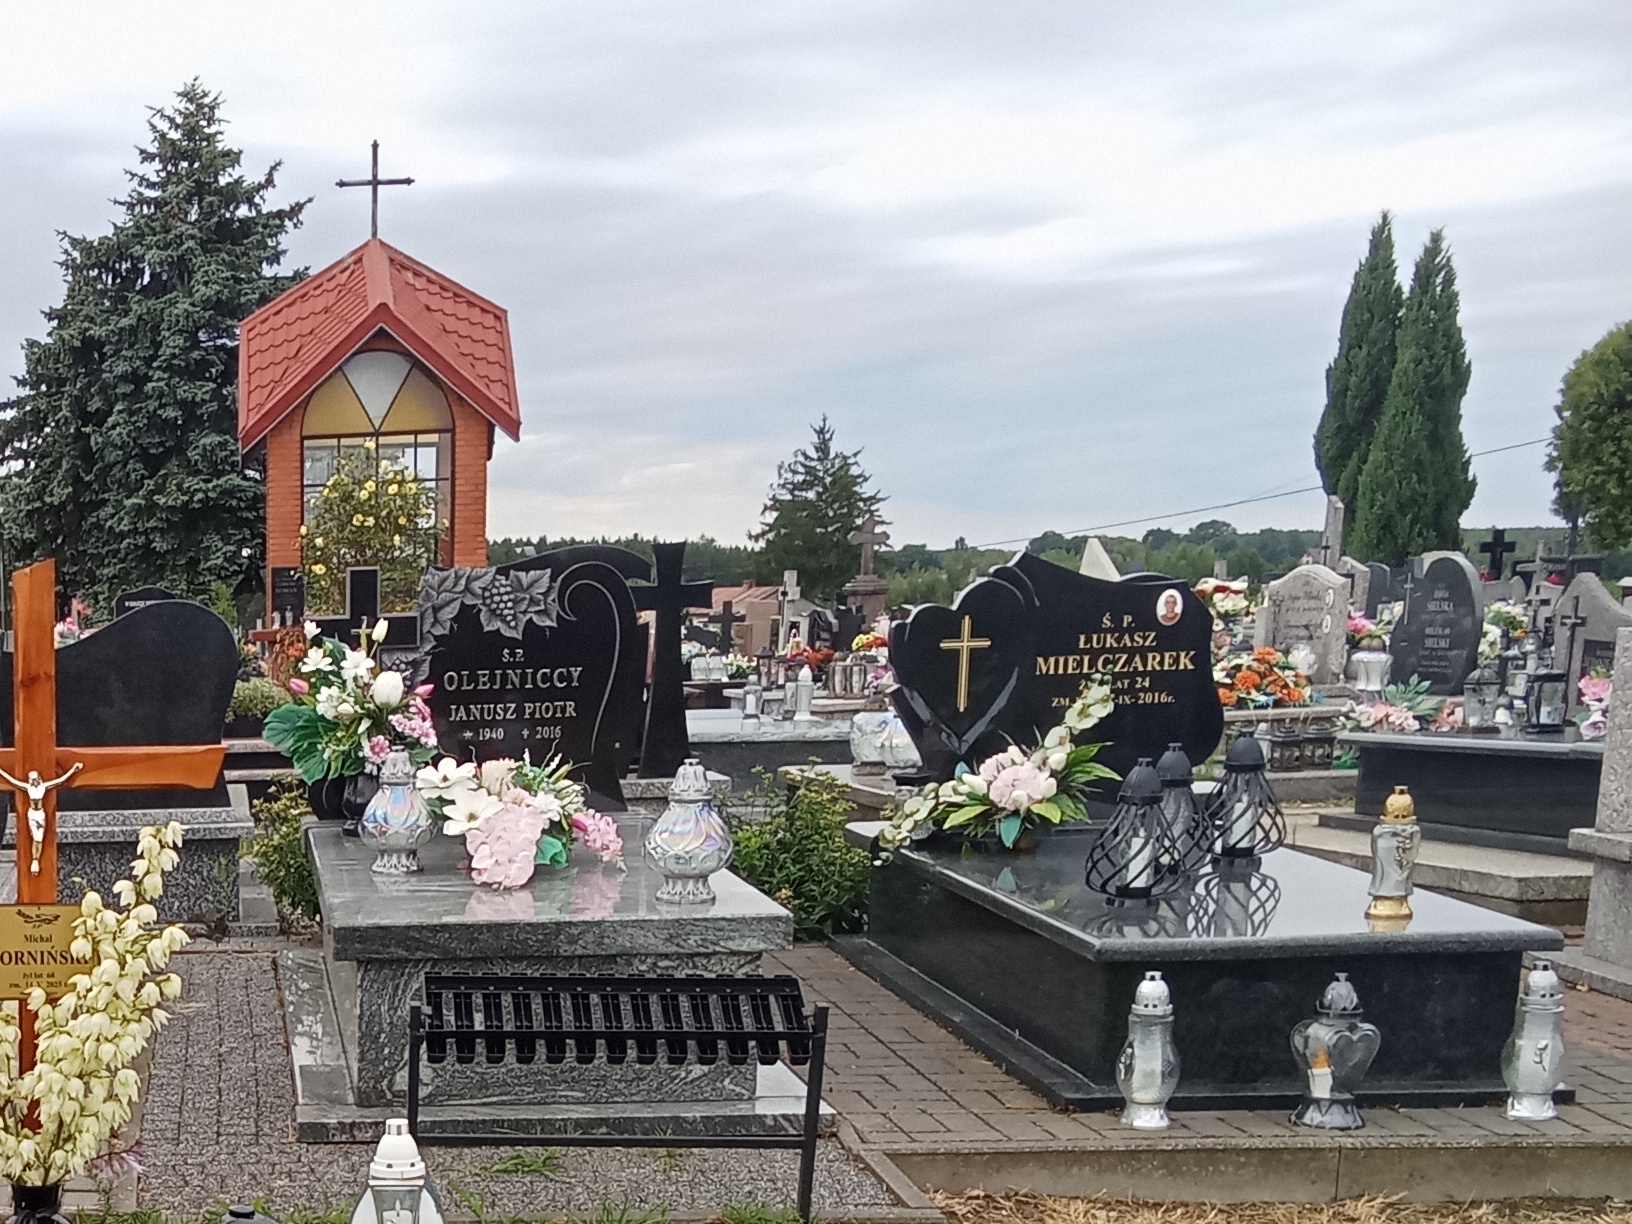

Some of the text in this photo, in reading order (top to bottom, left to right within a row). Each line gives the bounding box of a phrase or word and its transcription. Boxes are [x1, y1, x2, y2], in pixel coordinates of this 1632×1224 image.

[1078, 631, 1158, 649] ŁUKASZ
[1035, 650, 1197, 676] MIELCZAREK
[443, 666, 583, 692] OLEJNICCY
[1135, 676, 1150, 689] 24
[448, 701, 577, 722] JANUSZ PIOTR
[478, 725, 562, 741] 1940 2016
